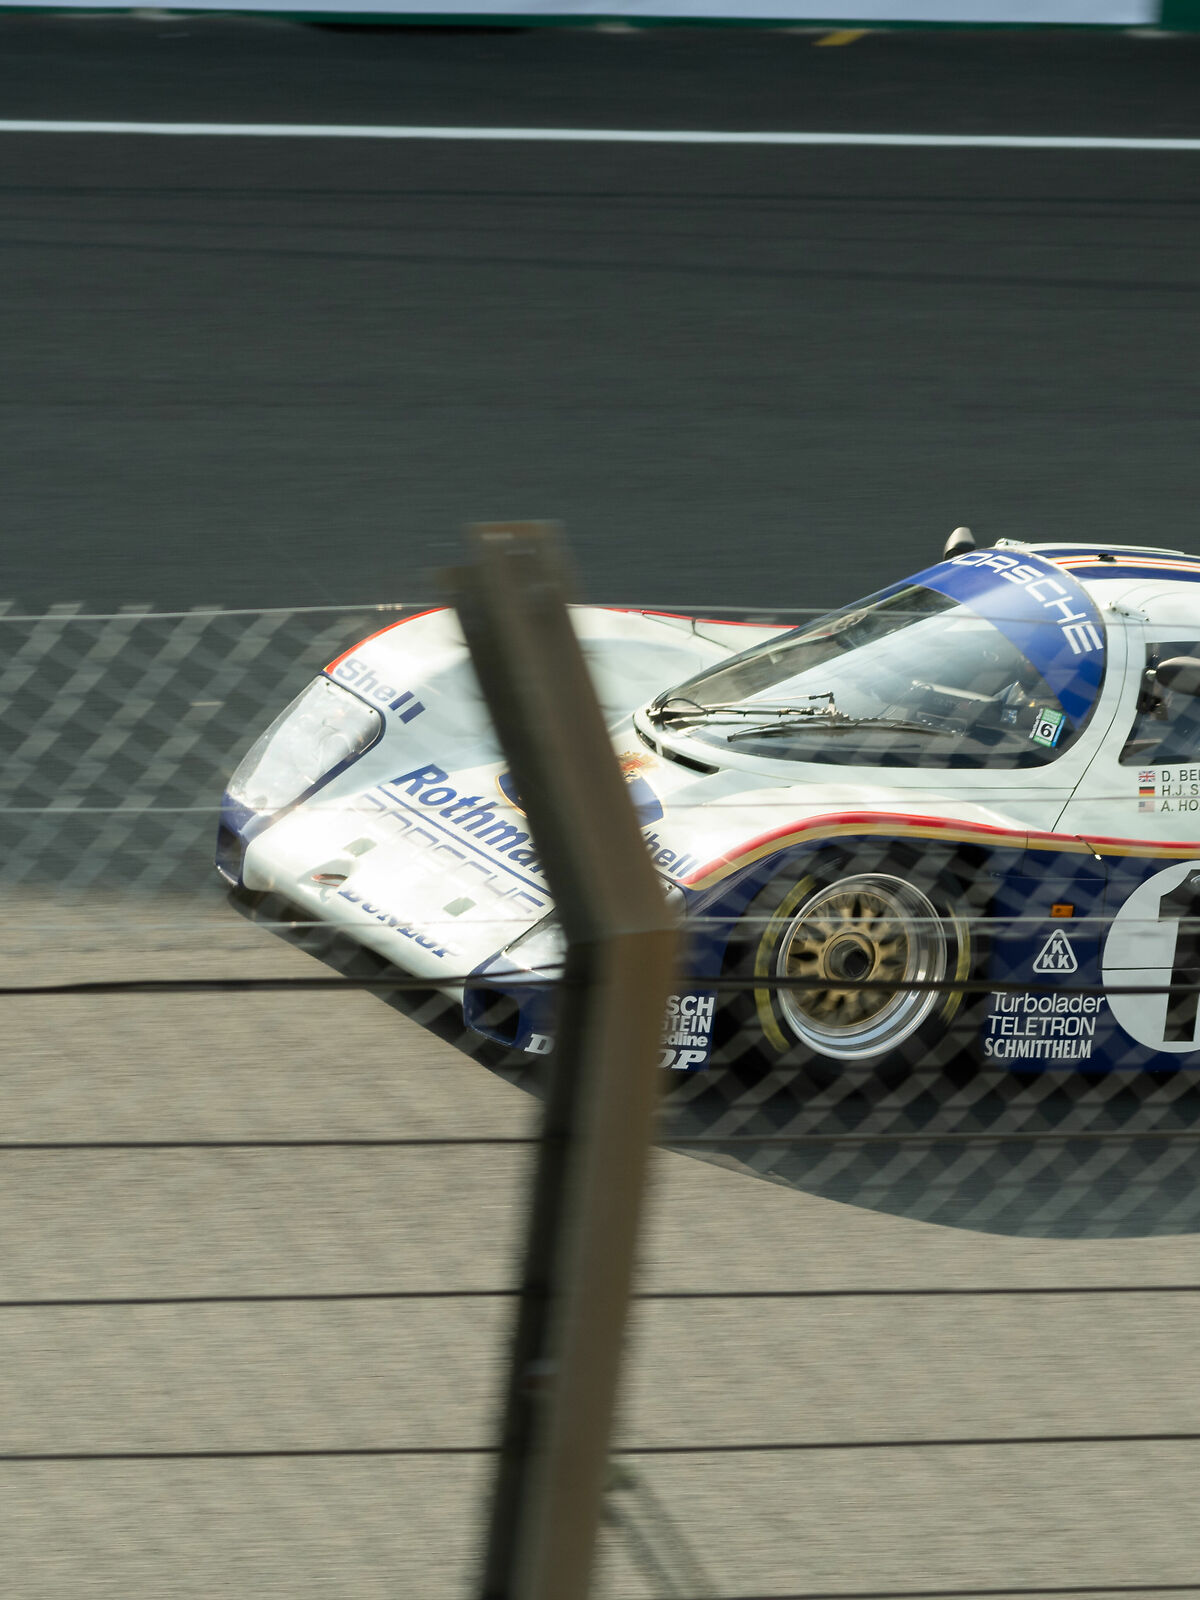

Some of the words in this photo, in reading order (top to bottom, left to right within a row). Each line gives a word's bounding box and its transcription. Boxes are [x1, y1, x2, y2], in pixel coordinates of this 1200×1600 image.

[952, 551, 1104, 655] ORSCHE
[335, 658, 426, 724] Shell
[1040, 723, 1054, 738] 6
[1161, 770, 1175, 782] D.
[1160, 799, 1175, 812] A.
[643, 831, 699, 878] hell
[665, 995, 715, 1016] SCH
[990, 992, 1107, 1013] Turbolader
[987, 1015, 1097, 1036] TELETRON
[984, 1037, 1093, 1059] SCHMITTHELM
